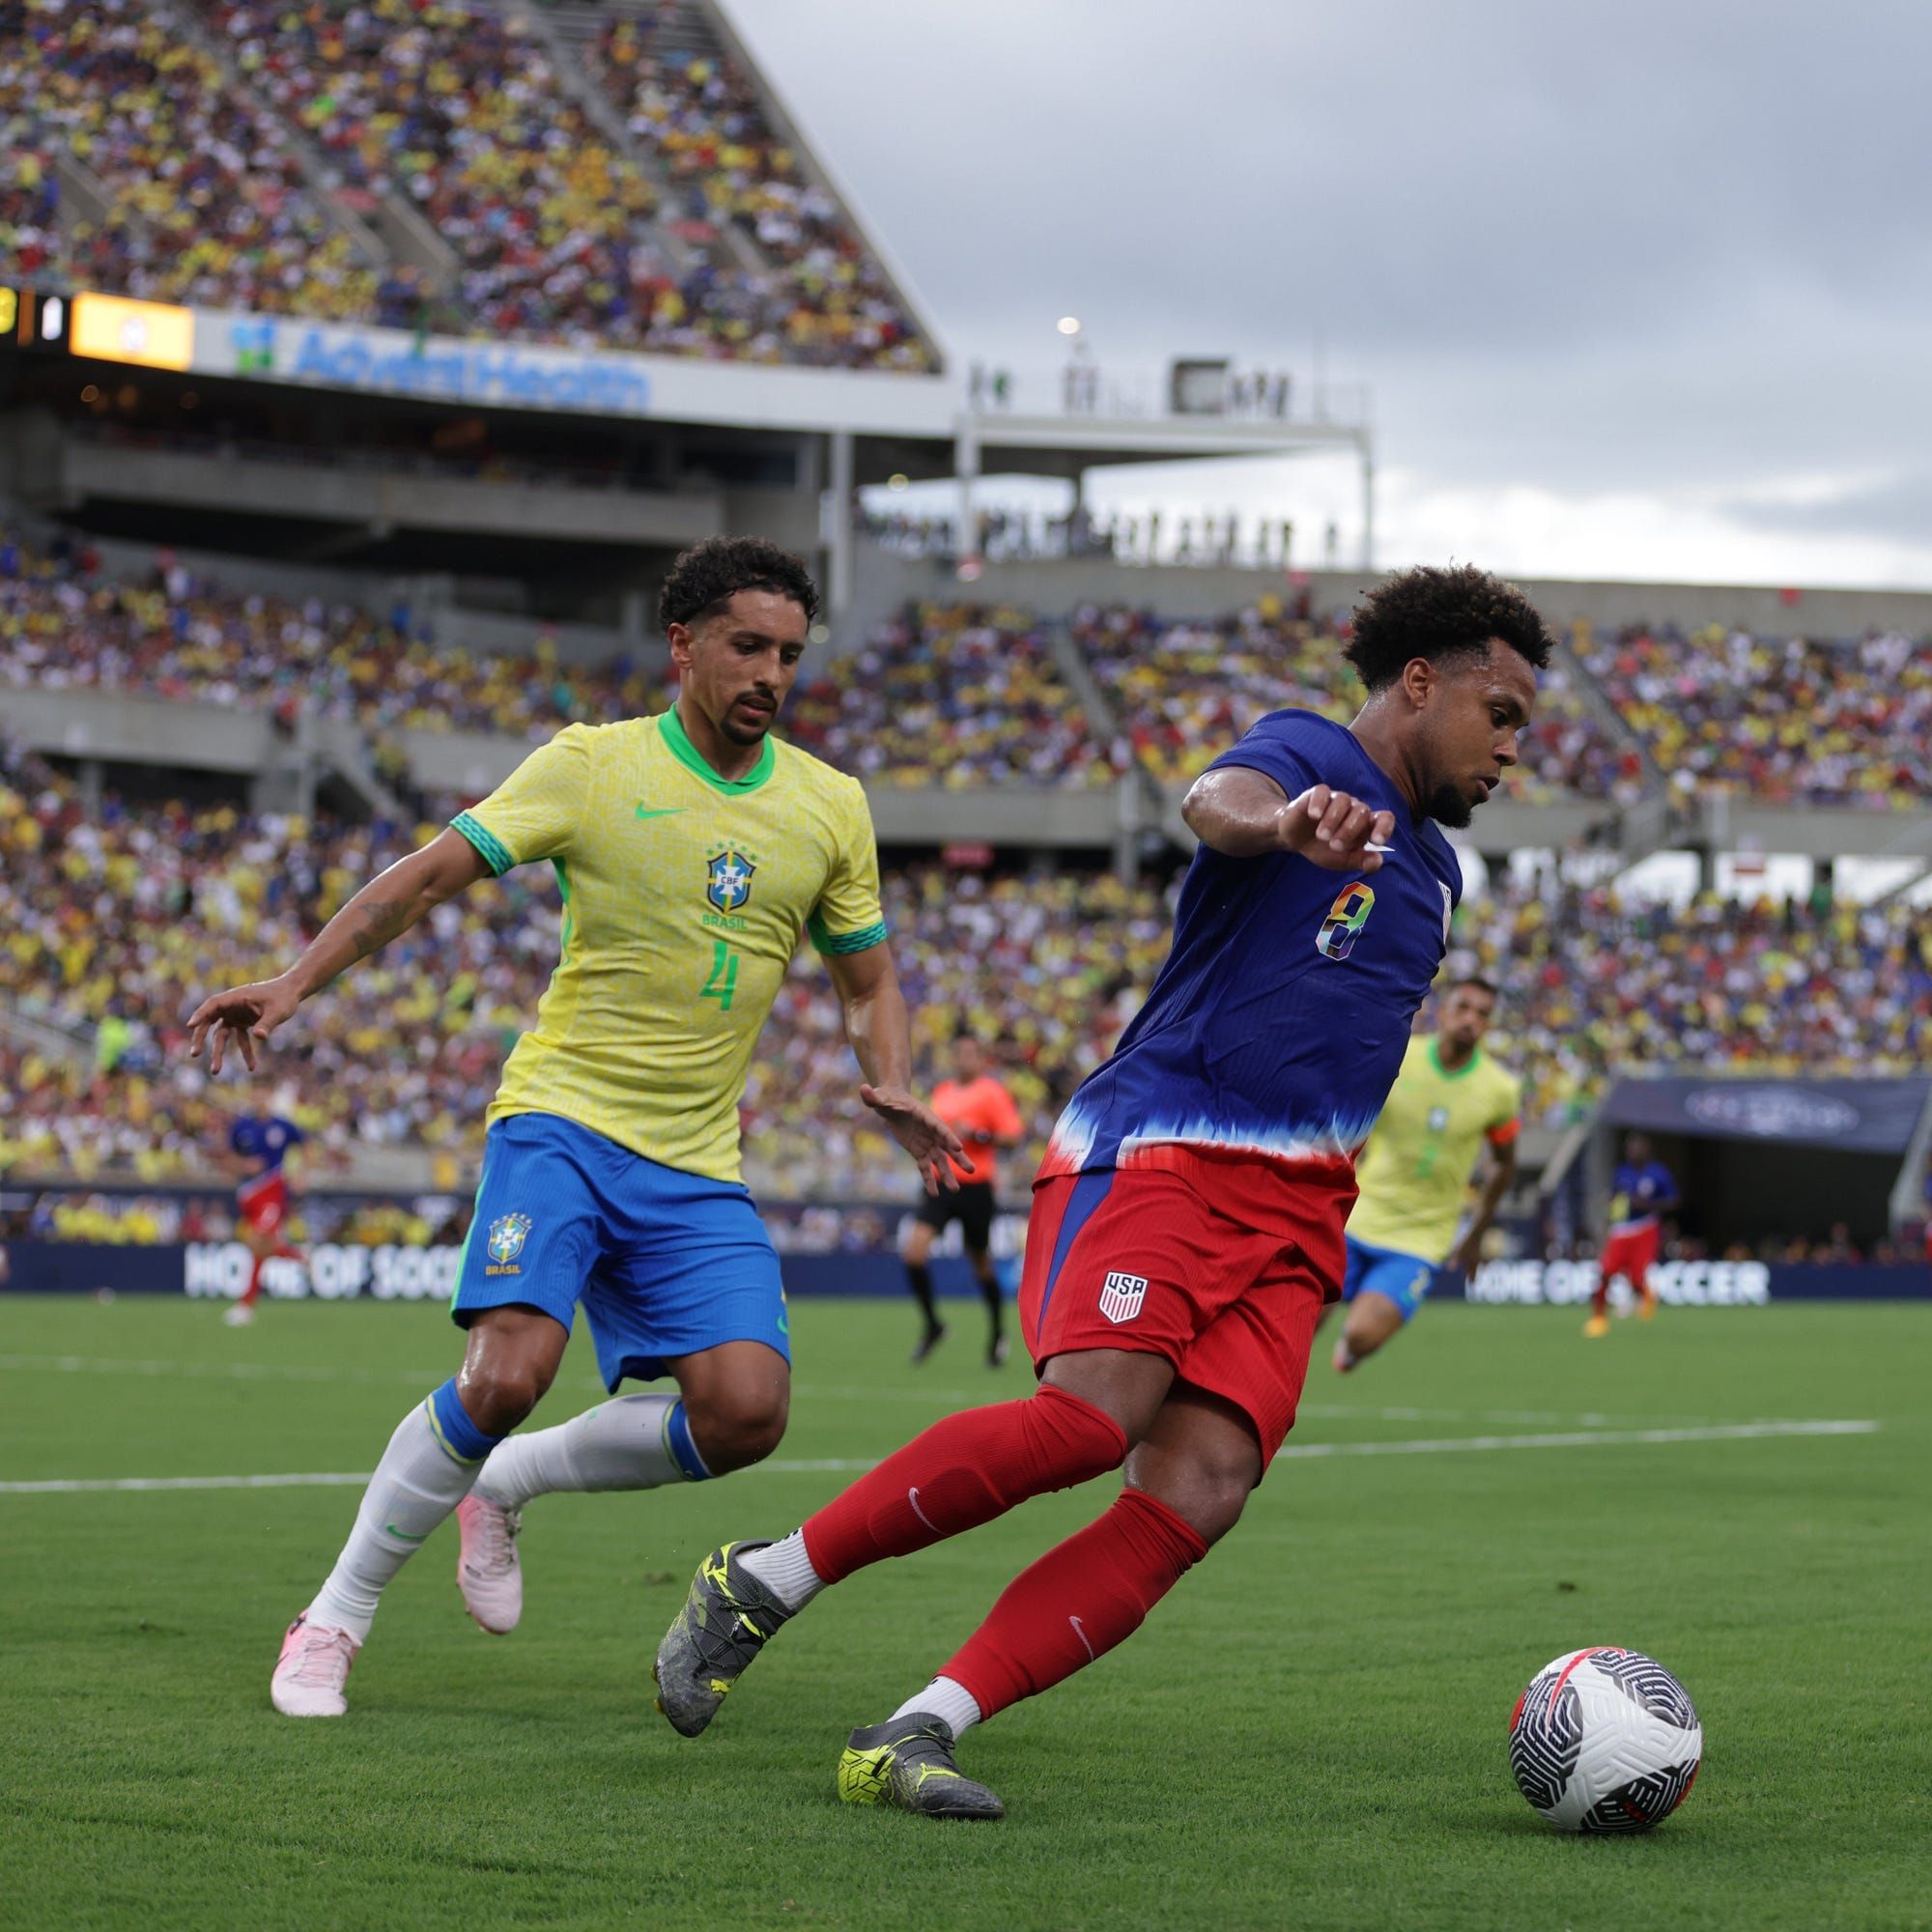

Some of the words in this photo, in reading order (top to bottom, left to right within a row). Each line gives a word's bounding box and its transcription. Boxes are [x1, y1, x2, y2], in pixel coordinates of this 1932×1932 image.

[721, 876, 739, 885] CBF
[702, 914, 747, 931] BRASIL
[1316, 881, 1375, 961] 8
[699, 941, 738, 1011] 4
[310, 1243, 370, 1299] OF
[371, 1245, 459, 1299] SOC
[486, 1264, 522, 1276] BRASIL
[1108, 1274, 1145, 1295] USA
